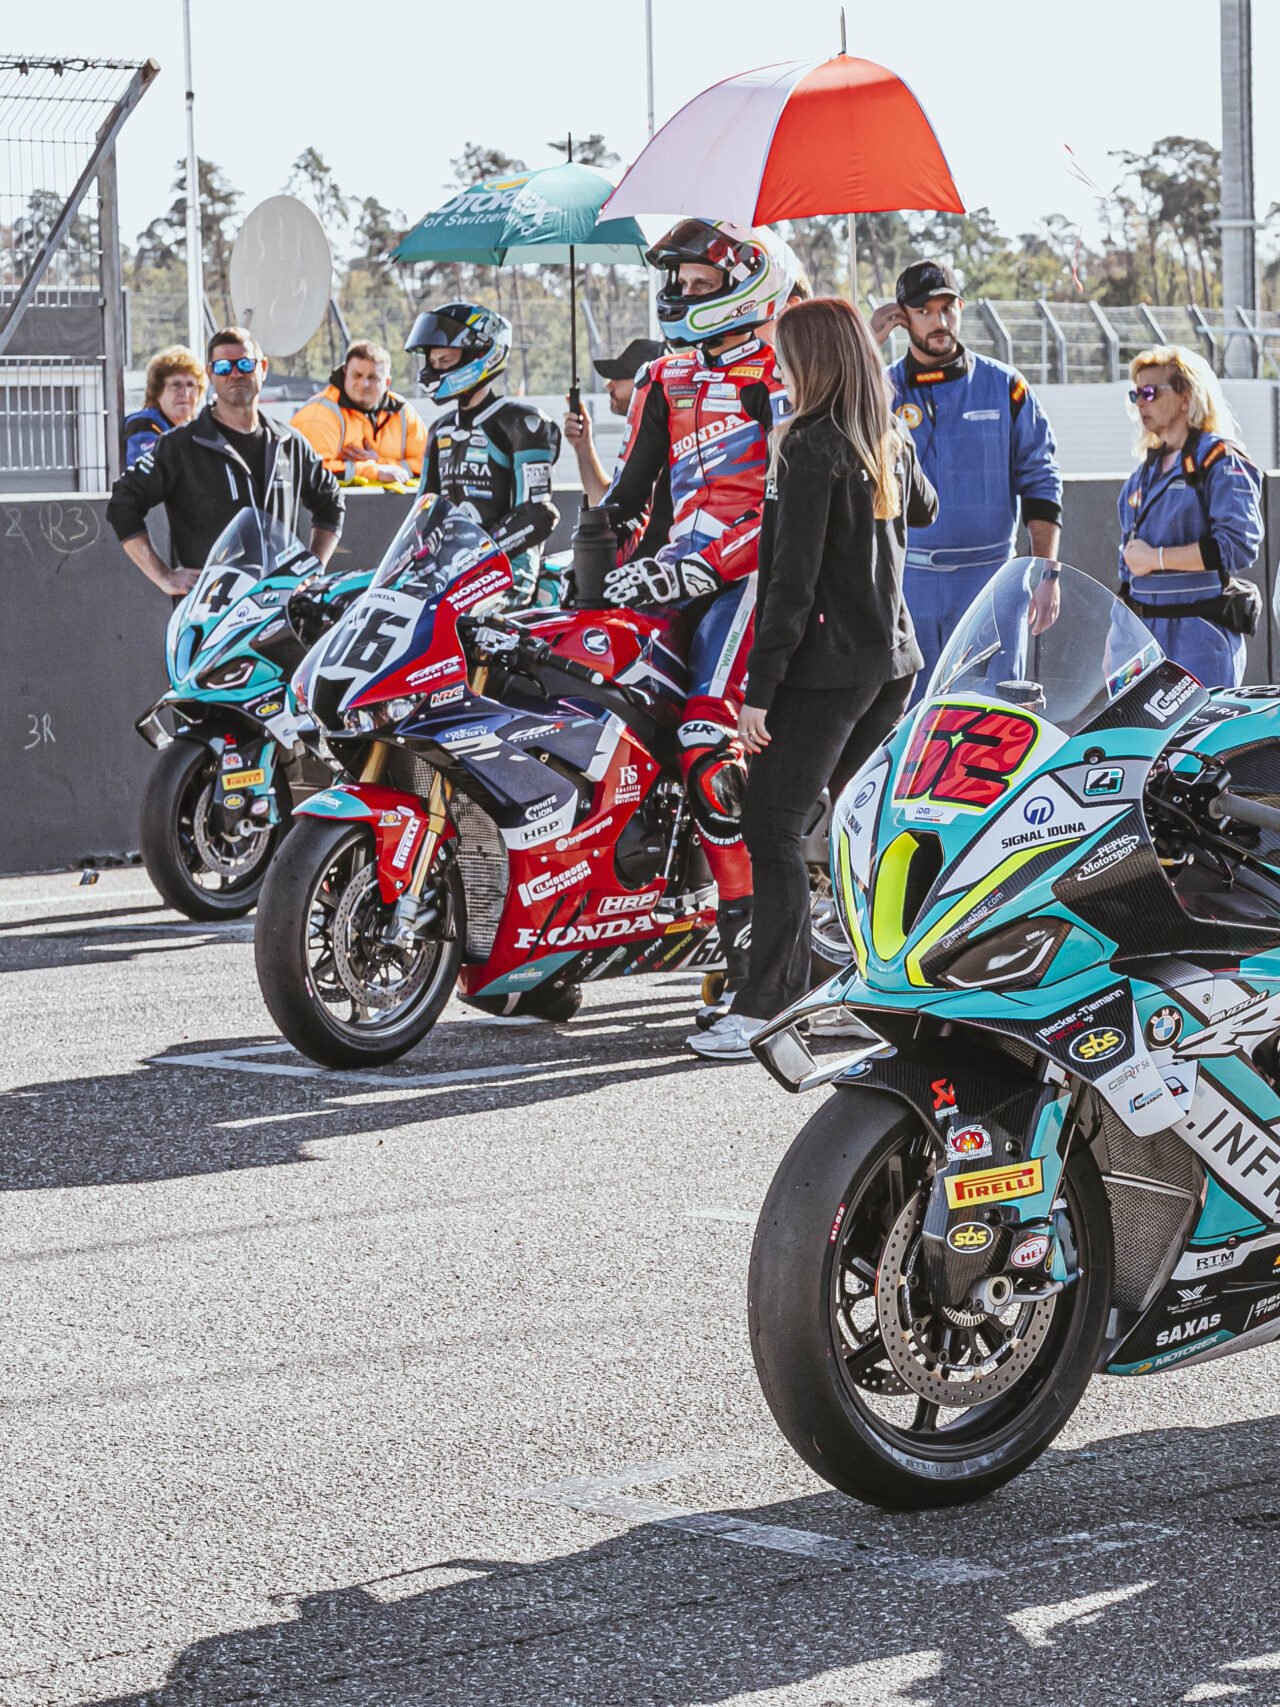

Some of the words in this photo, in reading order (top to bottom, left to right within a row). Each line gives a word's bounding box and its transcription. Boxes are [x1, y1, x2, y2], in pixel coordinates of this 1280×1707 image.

[424, 214, 440, 229] of
[662, 367, 691, 379] HRP
[728, 366, 764, 379] PIRELLI
[672, 413, 745, 457] HONDA
[47, 501, 89, 543] R3
[446, 568, 505, 605] HONDA
[453, 590, 484, 612] Financial
[482, 575, 512, 597] Services
[721, 630, 740, 668] WIMMI
[1159, 674, 1194, 709] ILMBERGER
[24, 711, 57, 751] 3R
[894, 704, 1038, 808] 52
[532, 794, 558, 812] WHITE
[532, 806, 553, 821] LION
[391, 815, 421, 870] PIRELLI
[523, 820, 560, 841] HRP
[567, 815, 614, 846] brehmergroup
[1001, 829, 1046, 850] SIGNAL
[1046, 821, 1087, 838] IDUNA
[1082, 842, 1138, 876] Motorsport
[536, 860, 590, 893] ILMBERGER
[604, 892, 656, 911] HRP
[514, 915, 654, 949] HONDA
[1040, 988, 1125, 1038] Becker-Tiemann
[1150, 1008, 1181, 1025] BMW
[1047, 1020, 1086, 1043] racing
[1078, 1030, 1119, 1060] sbs
[954, 1167, 1036, 1201] PIRELLI
[953, 1225, 988, 1246] sbs
[1020, 1247, 1044, 1263] HEL
[1196, 1251, 1236, 1269] RTM
[1156, 1313, 1222, 1347] SAXAS
[1155, 1334, 1220, 1367] MOTOREX
